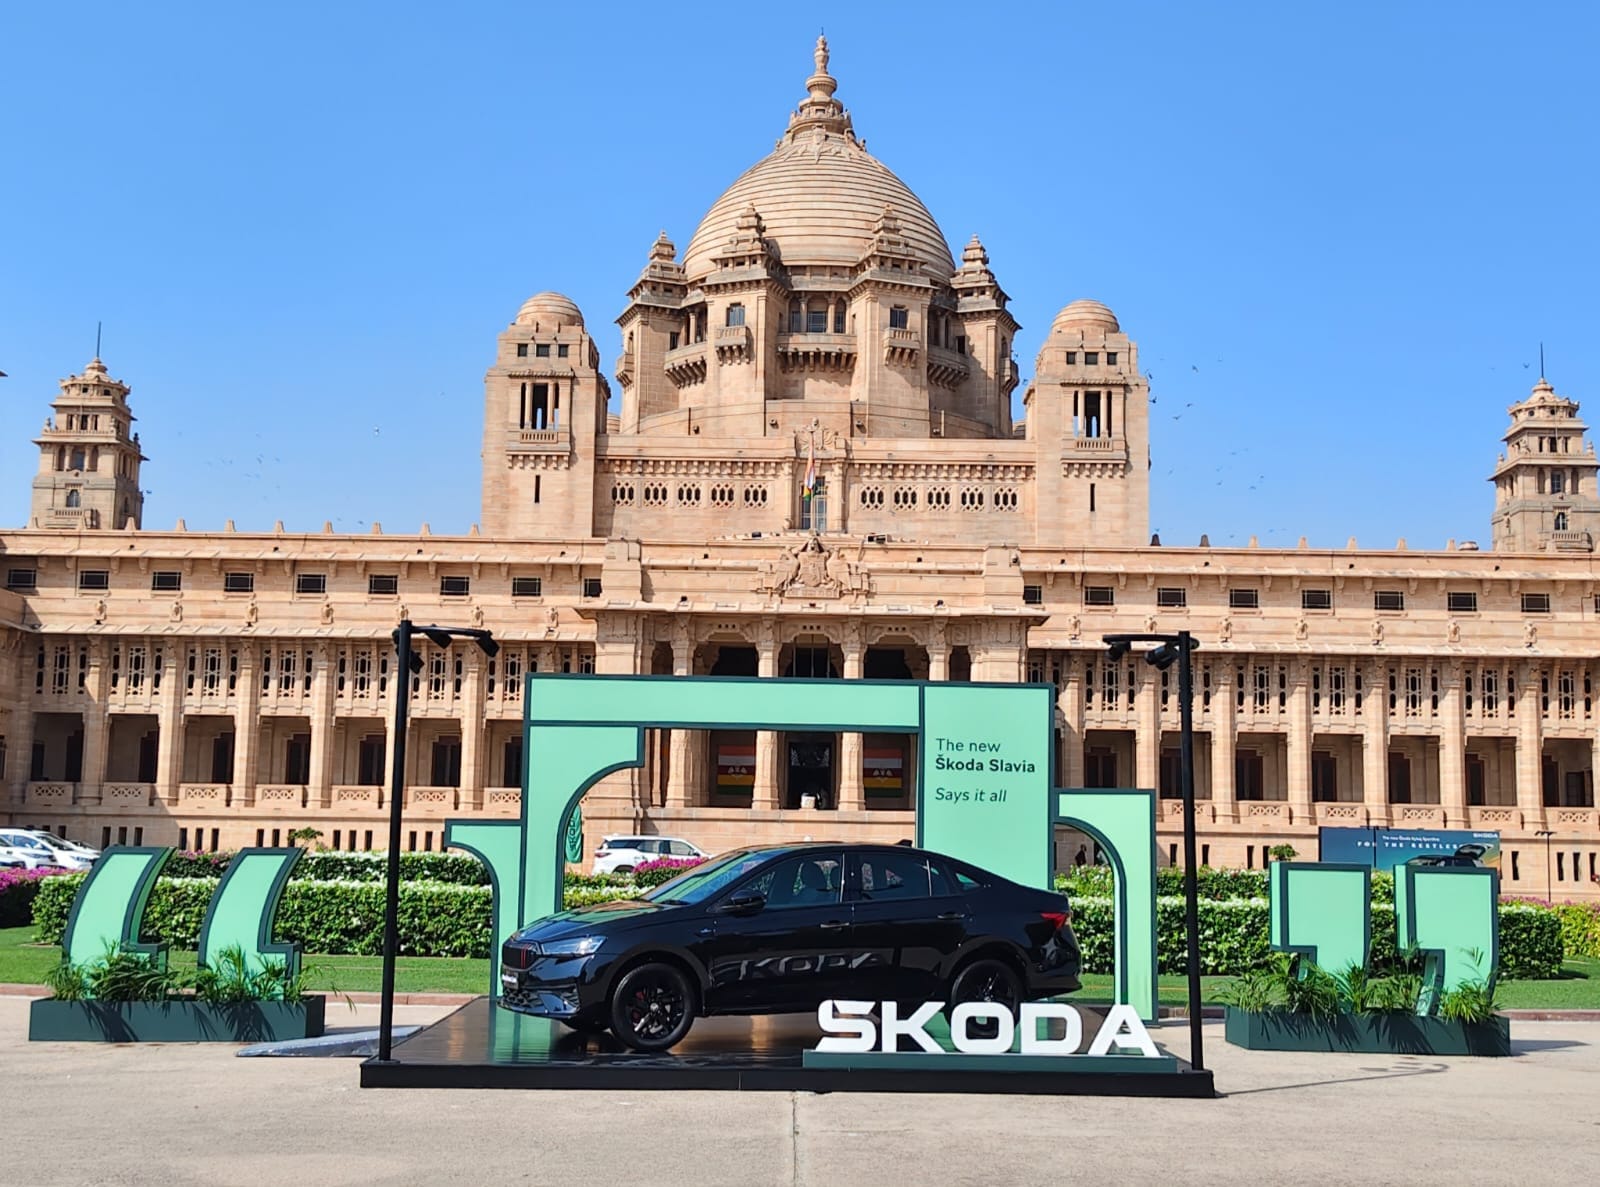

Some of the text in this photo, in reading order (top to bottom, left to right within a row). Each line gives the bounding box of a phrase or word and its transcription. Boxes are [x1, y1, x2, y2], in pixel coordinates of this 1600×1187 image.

[936, 738, 1001, 753] The new
[935, 754, 1035, 773] Škoda Slavia
[935, 787, 1007, 805] Says it all
